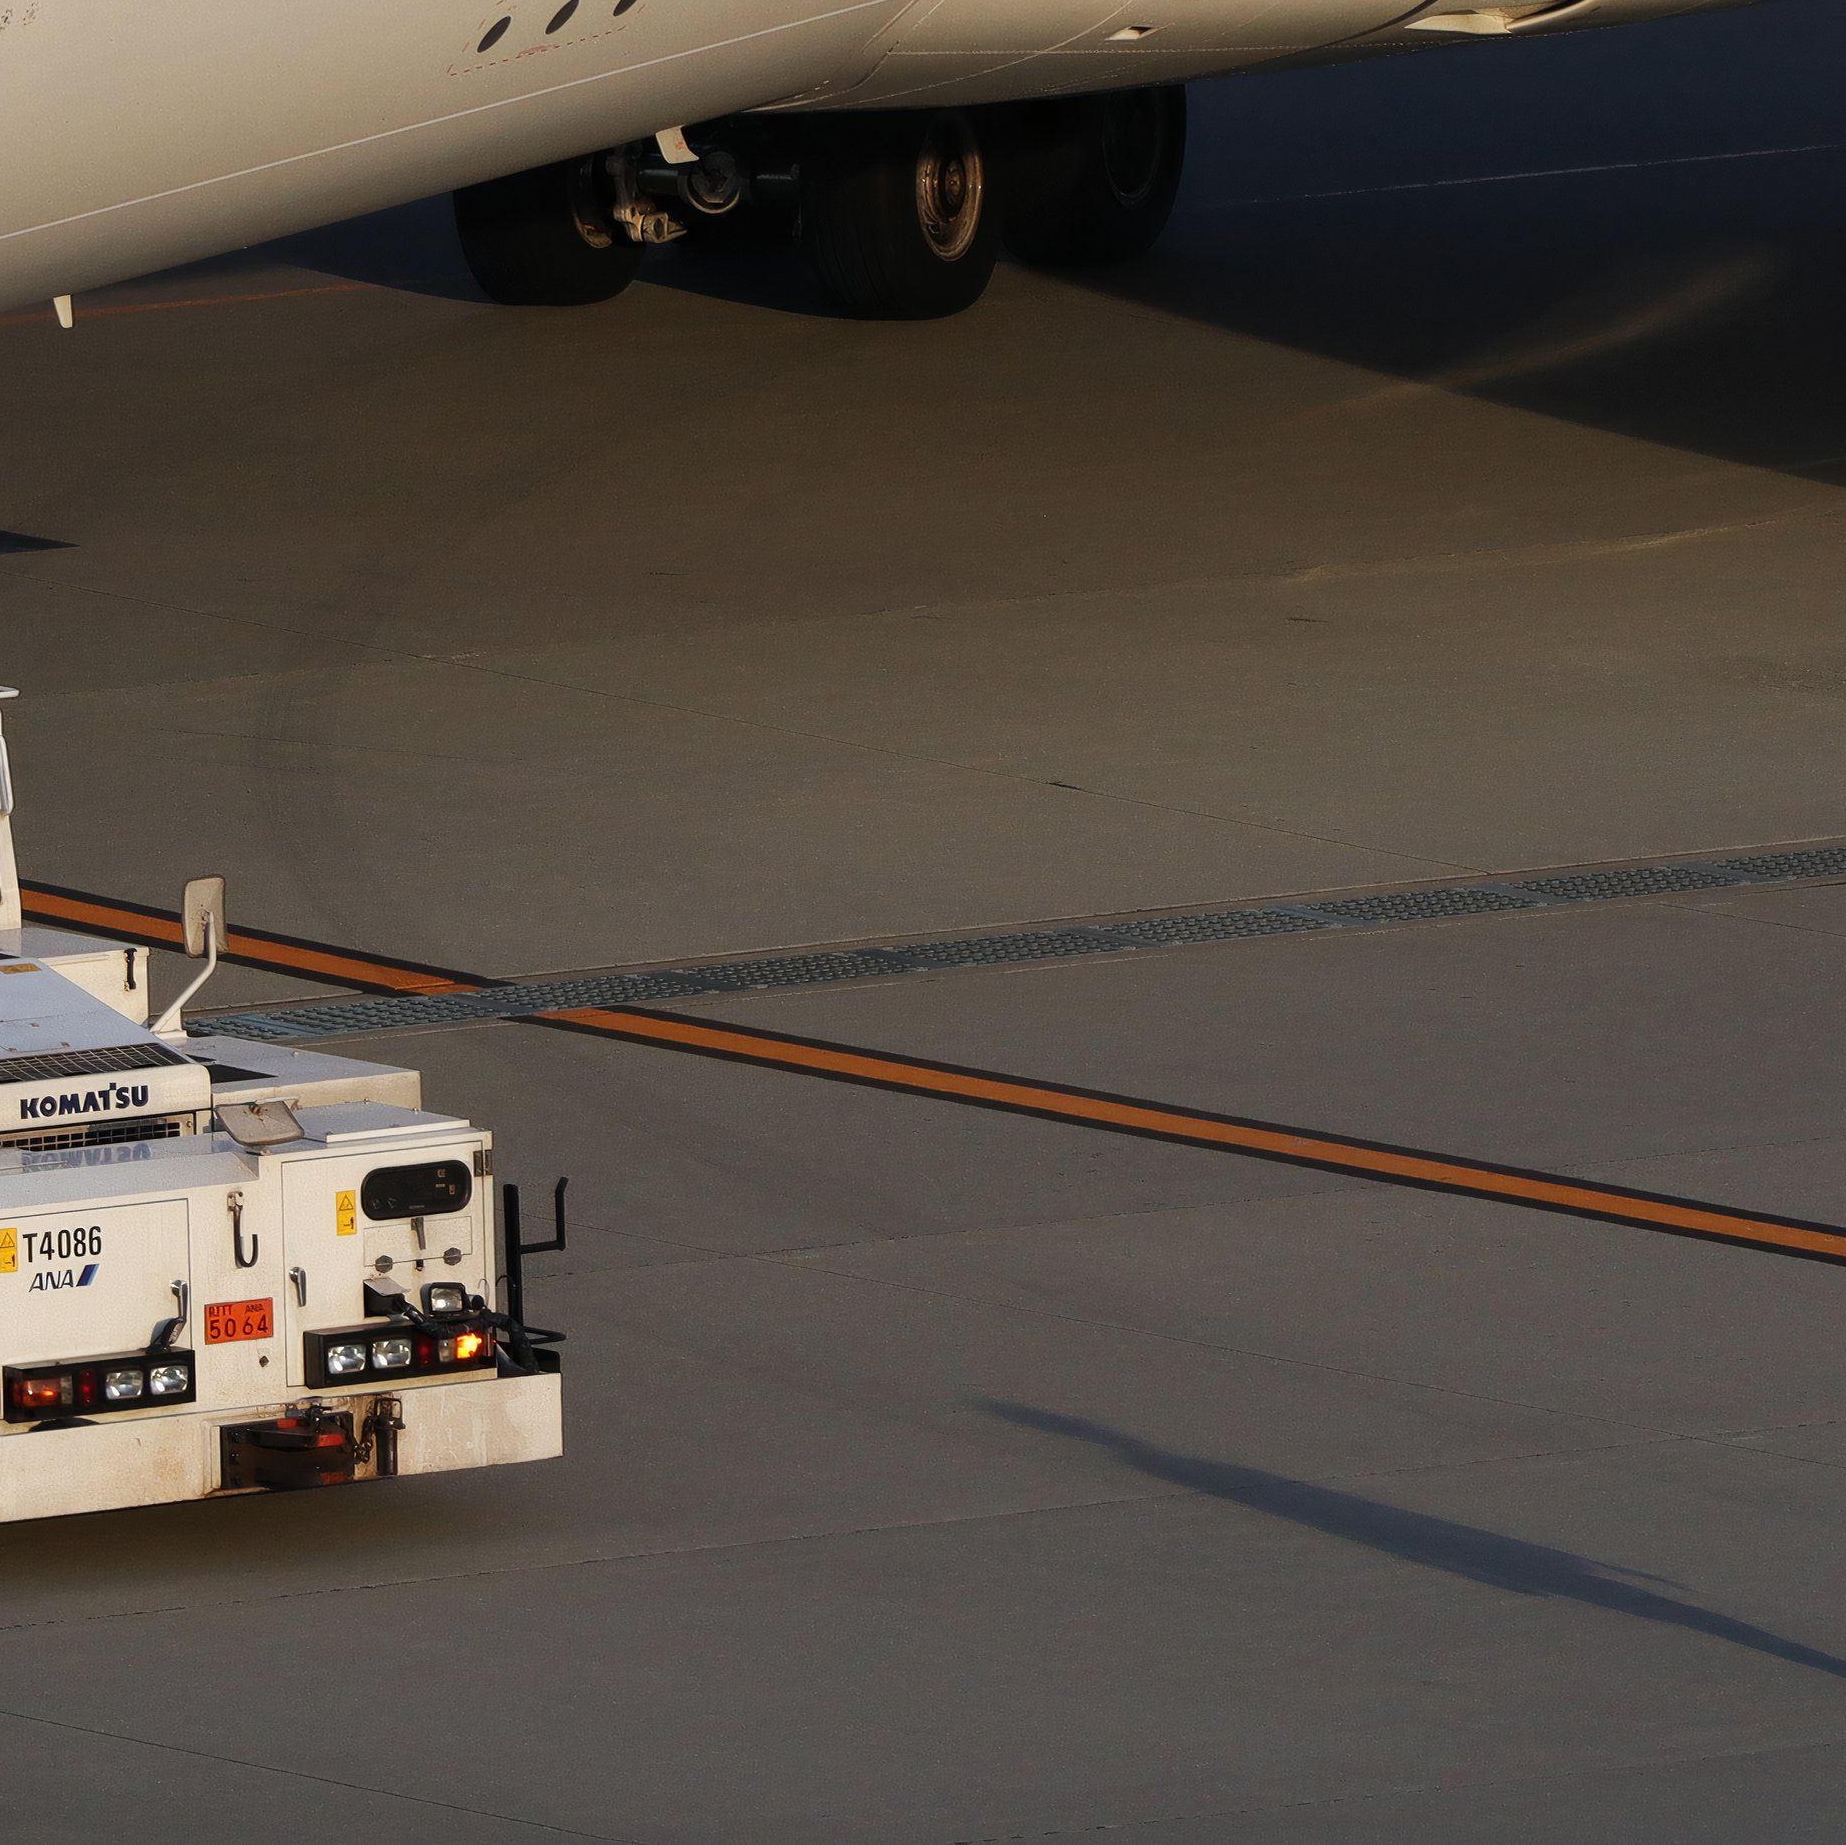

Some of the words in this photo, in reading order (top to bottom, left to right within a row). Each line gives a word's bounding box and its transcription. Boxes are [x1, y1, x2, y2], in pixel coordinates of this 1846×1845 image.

[20, 1082, 149, 1120] KOMATSU
[22, 1226, 102, 1263] T4086
[28, 1269, 74, 1293] ANA
